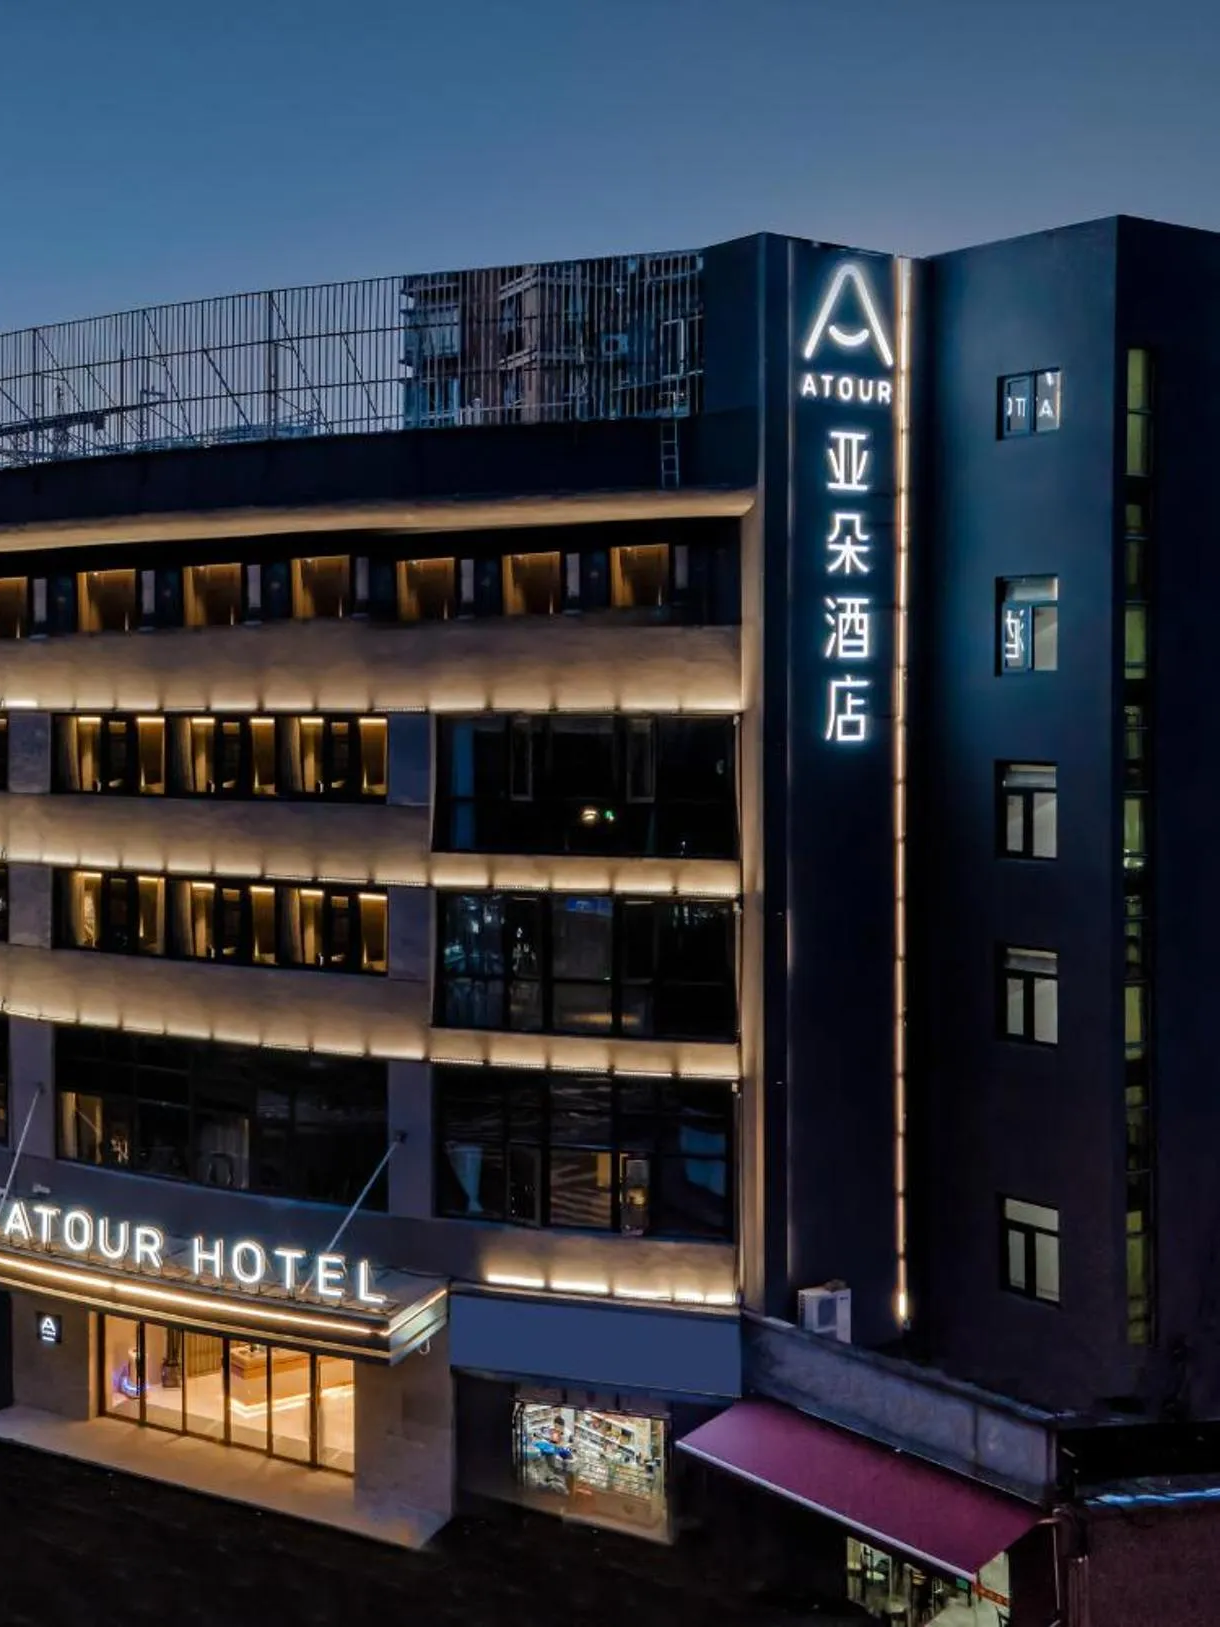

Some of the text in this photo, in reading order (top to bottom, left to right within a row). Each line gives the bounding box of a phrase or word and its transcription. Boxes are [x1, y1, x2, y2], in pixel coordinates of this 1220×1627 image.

[801, 374, 892, 404] ATOUR
[826, 431, 869, 742] 亚朵酒店
[4, 1201, 165, 1268] ATOUR
[192, 1234, 388, 1304] HOTEL
